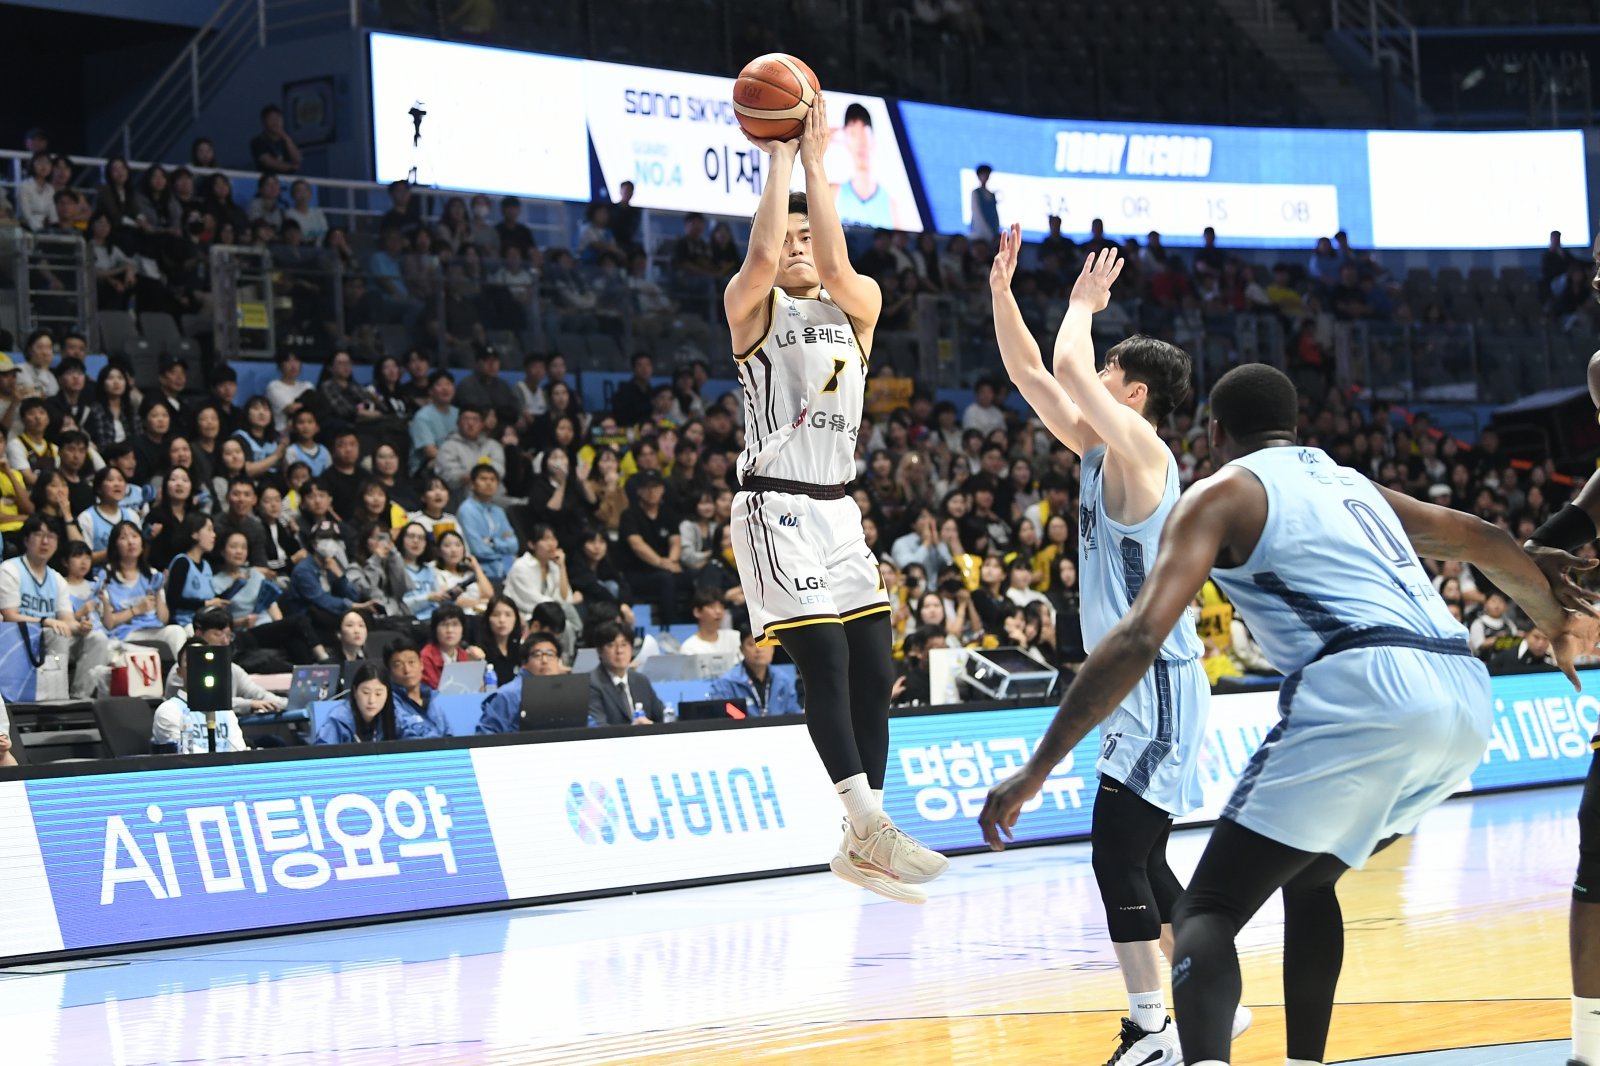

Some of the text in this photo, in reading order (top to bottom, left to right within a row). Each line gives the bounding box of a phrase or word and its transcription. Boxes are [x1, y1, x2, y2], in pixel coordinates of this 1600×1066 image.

[625, 89, 680, 119] SONO
[634, 158, 683, 188] NO.4
[775, 330, 797, 348] LG
[802, 327, 847, 344] 올레드
[1343, 499, 1416, 568] 0
[794, 577, 819, 591] LG
[100, 785, 458, 905] Ai 미팅요약
